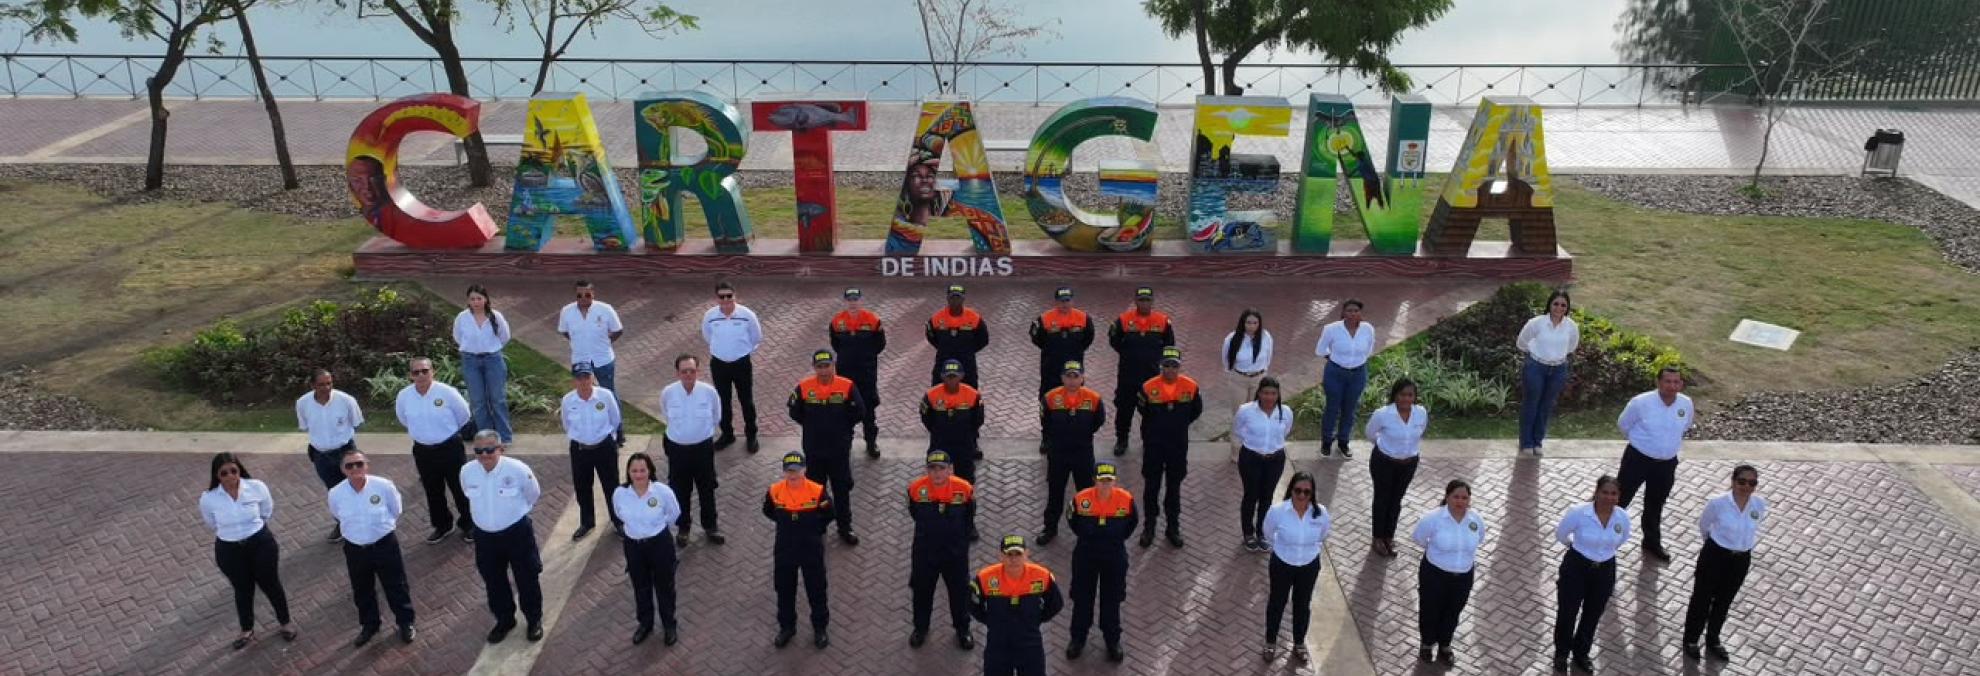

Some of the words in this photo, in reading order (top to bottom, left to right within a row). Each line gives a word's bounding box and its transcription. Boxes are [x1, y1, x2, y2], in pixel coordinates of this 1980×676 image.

[346, 92, 1558, 256] CARTAGENA
[881, 257, 914, 276] DE
[923, 256, 1014, 277] INDIAS
